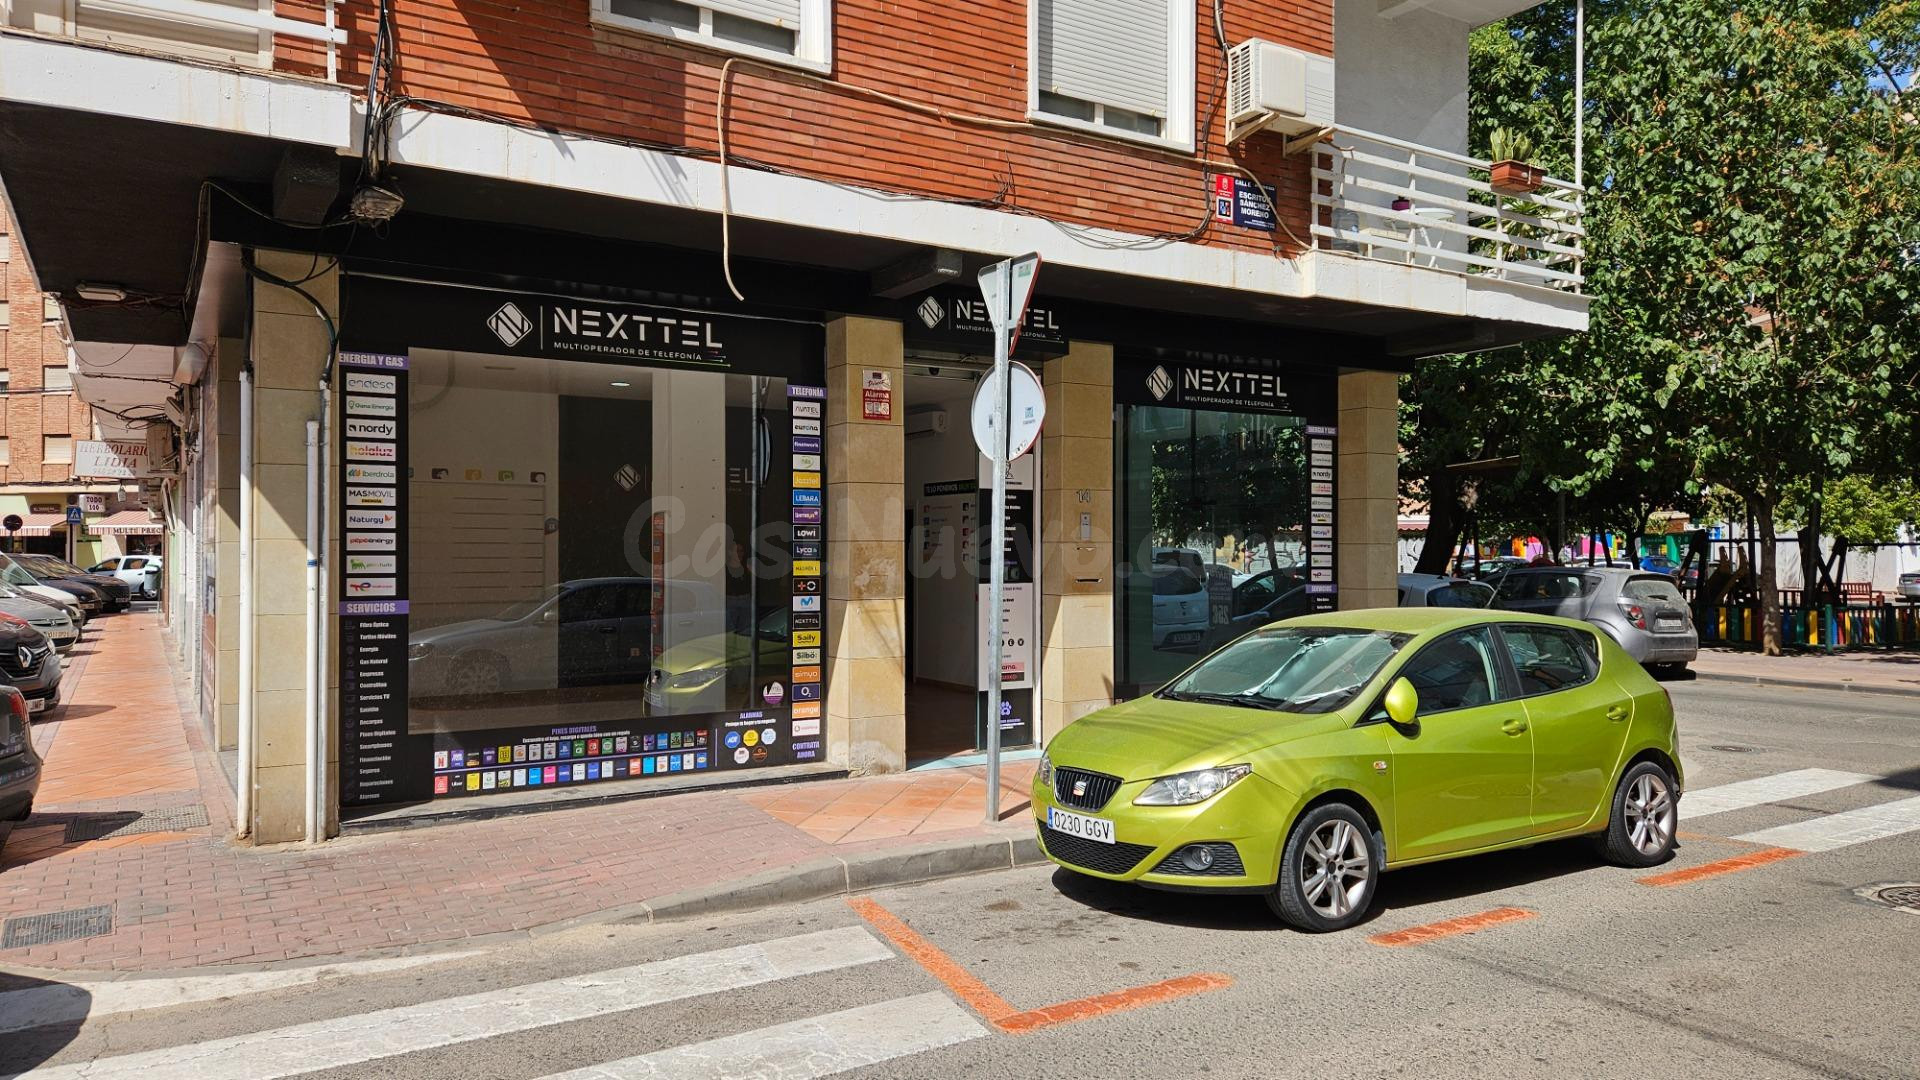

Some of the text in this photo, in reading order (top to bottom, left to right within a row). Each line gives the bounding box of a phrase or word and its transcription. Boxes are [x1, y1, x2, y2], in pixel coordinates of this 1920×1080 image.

[1240, 207, 1270, 219] MORENO
[956, 299, 1060, 330] NETEL
[554, 307, 723, 348] NEXTTEL
[553, 341, 636, 355] MULTIOPERADOR
[652, 350, 702, 361] TELEFONÍA
[377, 356, 384, 366] Y
[385, 356, 404, 367] GAS
[348, 379, 394, 390] endesa
[1185, 368, 1288, 397] NEXTTEL
[1185, 396, 1234, 404] MULTIOPERADOR
[359, 423, 393, 435] nordy
[94, 456, 137, 468] LIDIA
[795, 494, 819, 502] LEBARA
[1076, 488, 1090, 503] 14
[349, 516, 384, 524] Naturgy
[796, 546, 813, 554] Lyca
[346, 603, 396, 613] SERVICIOS
[1054, 811, 1110, 839] 0230 GGV
